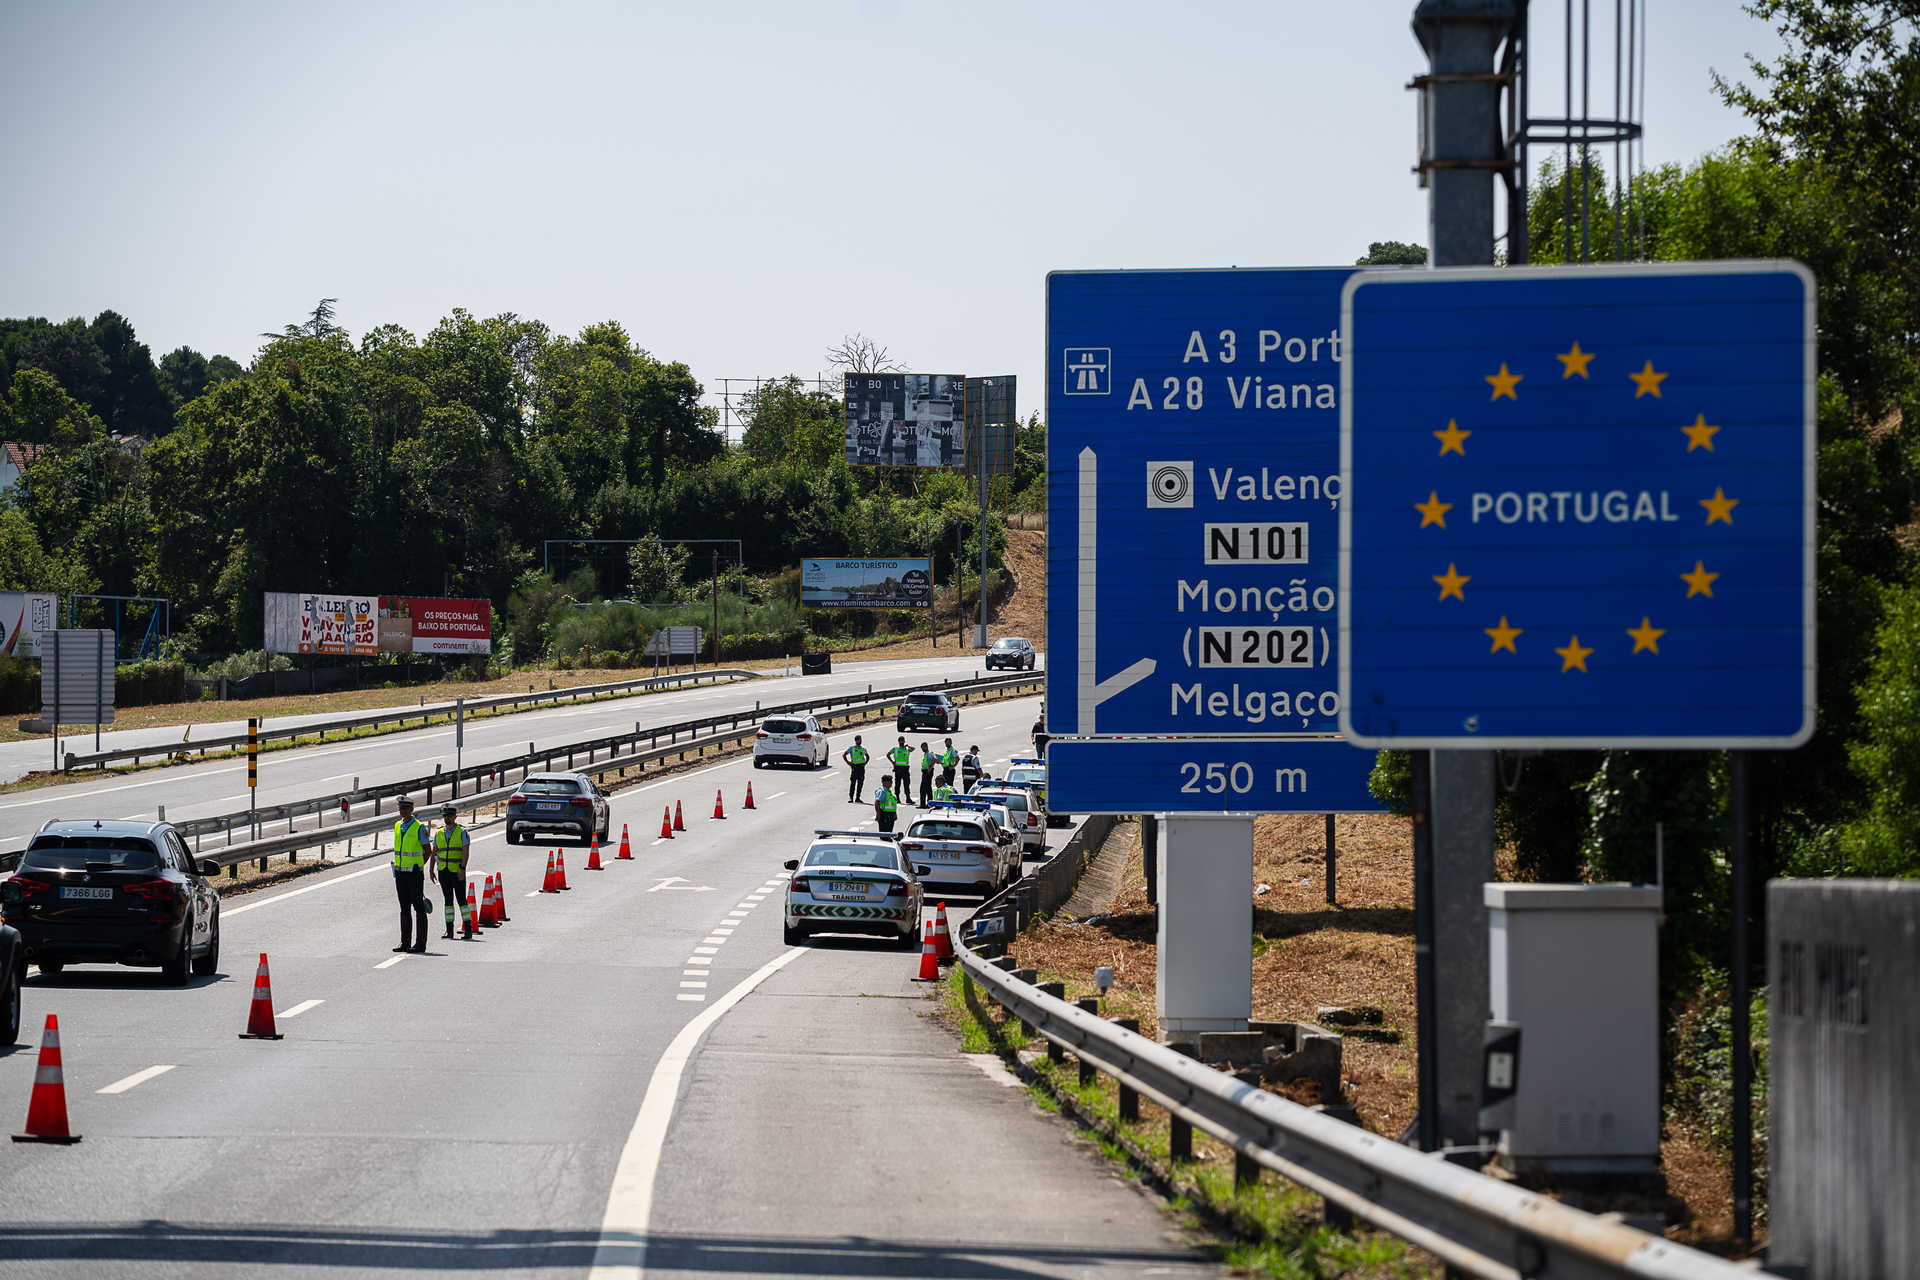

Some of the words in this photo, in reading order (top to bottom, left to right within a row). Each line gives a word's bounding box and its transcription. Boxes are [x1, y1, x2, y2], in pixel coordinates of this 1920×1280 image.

[1259, 329, 1344, 363] Port
[1227, 376, 1336, 409] Viana
[1208, 467, 1342, 510] Valenç
[1471, 490, 1680, 524] PORTUGAL
[835, 561, 860, 569] BARCO
[861, 560, 898, 569] TURÍSTICO
[424, 611, 434, 619] OS
[435, 612, 462, 622] PREÇOS
[462, 613, 479, 621] MAIS
[1177, 578, 1335, 622] Monção
[418, 622, 438, 630] BAIXO
[439, 623, 449, 631] DE
[449, 623, 485, 632] PORTUGAL
[1171, 683, 1342, 728] Melgaço
[1180, 762, 1254, 793] 250
[1275, 767, 1307, 793] m
[66, 888, 90, 898] 7366
